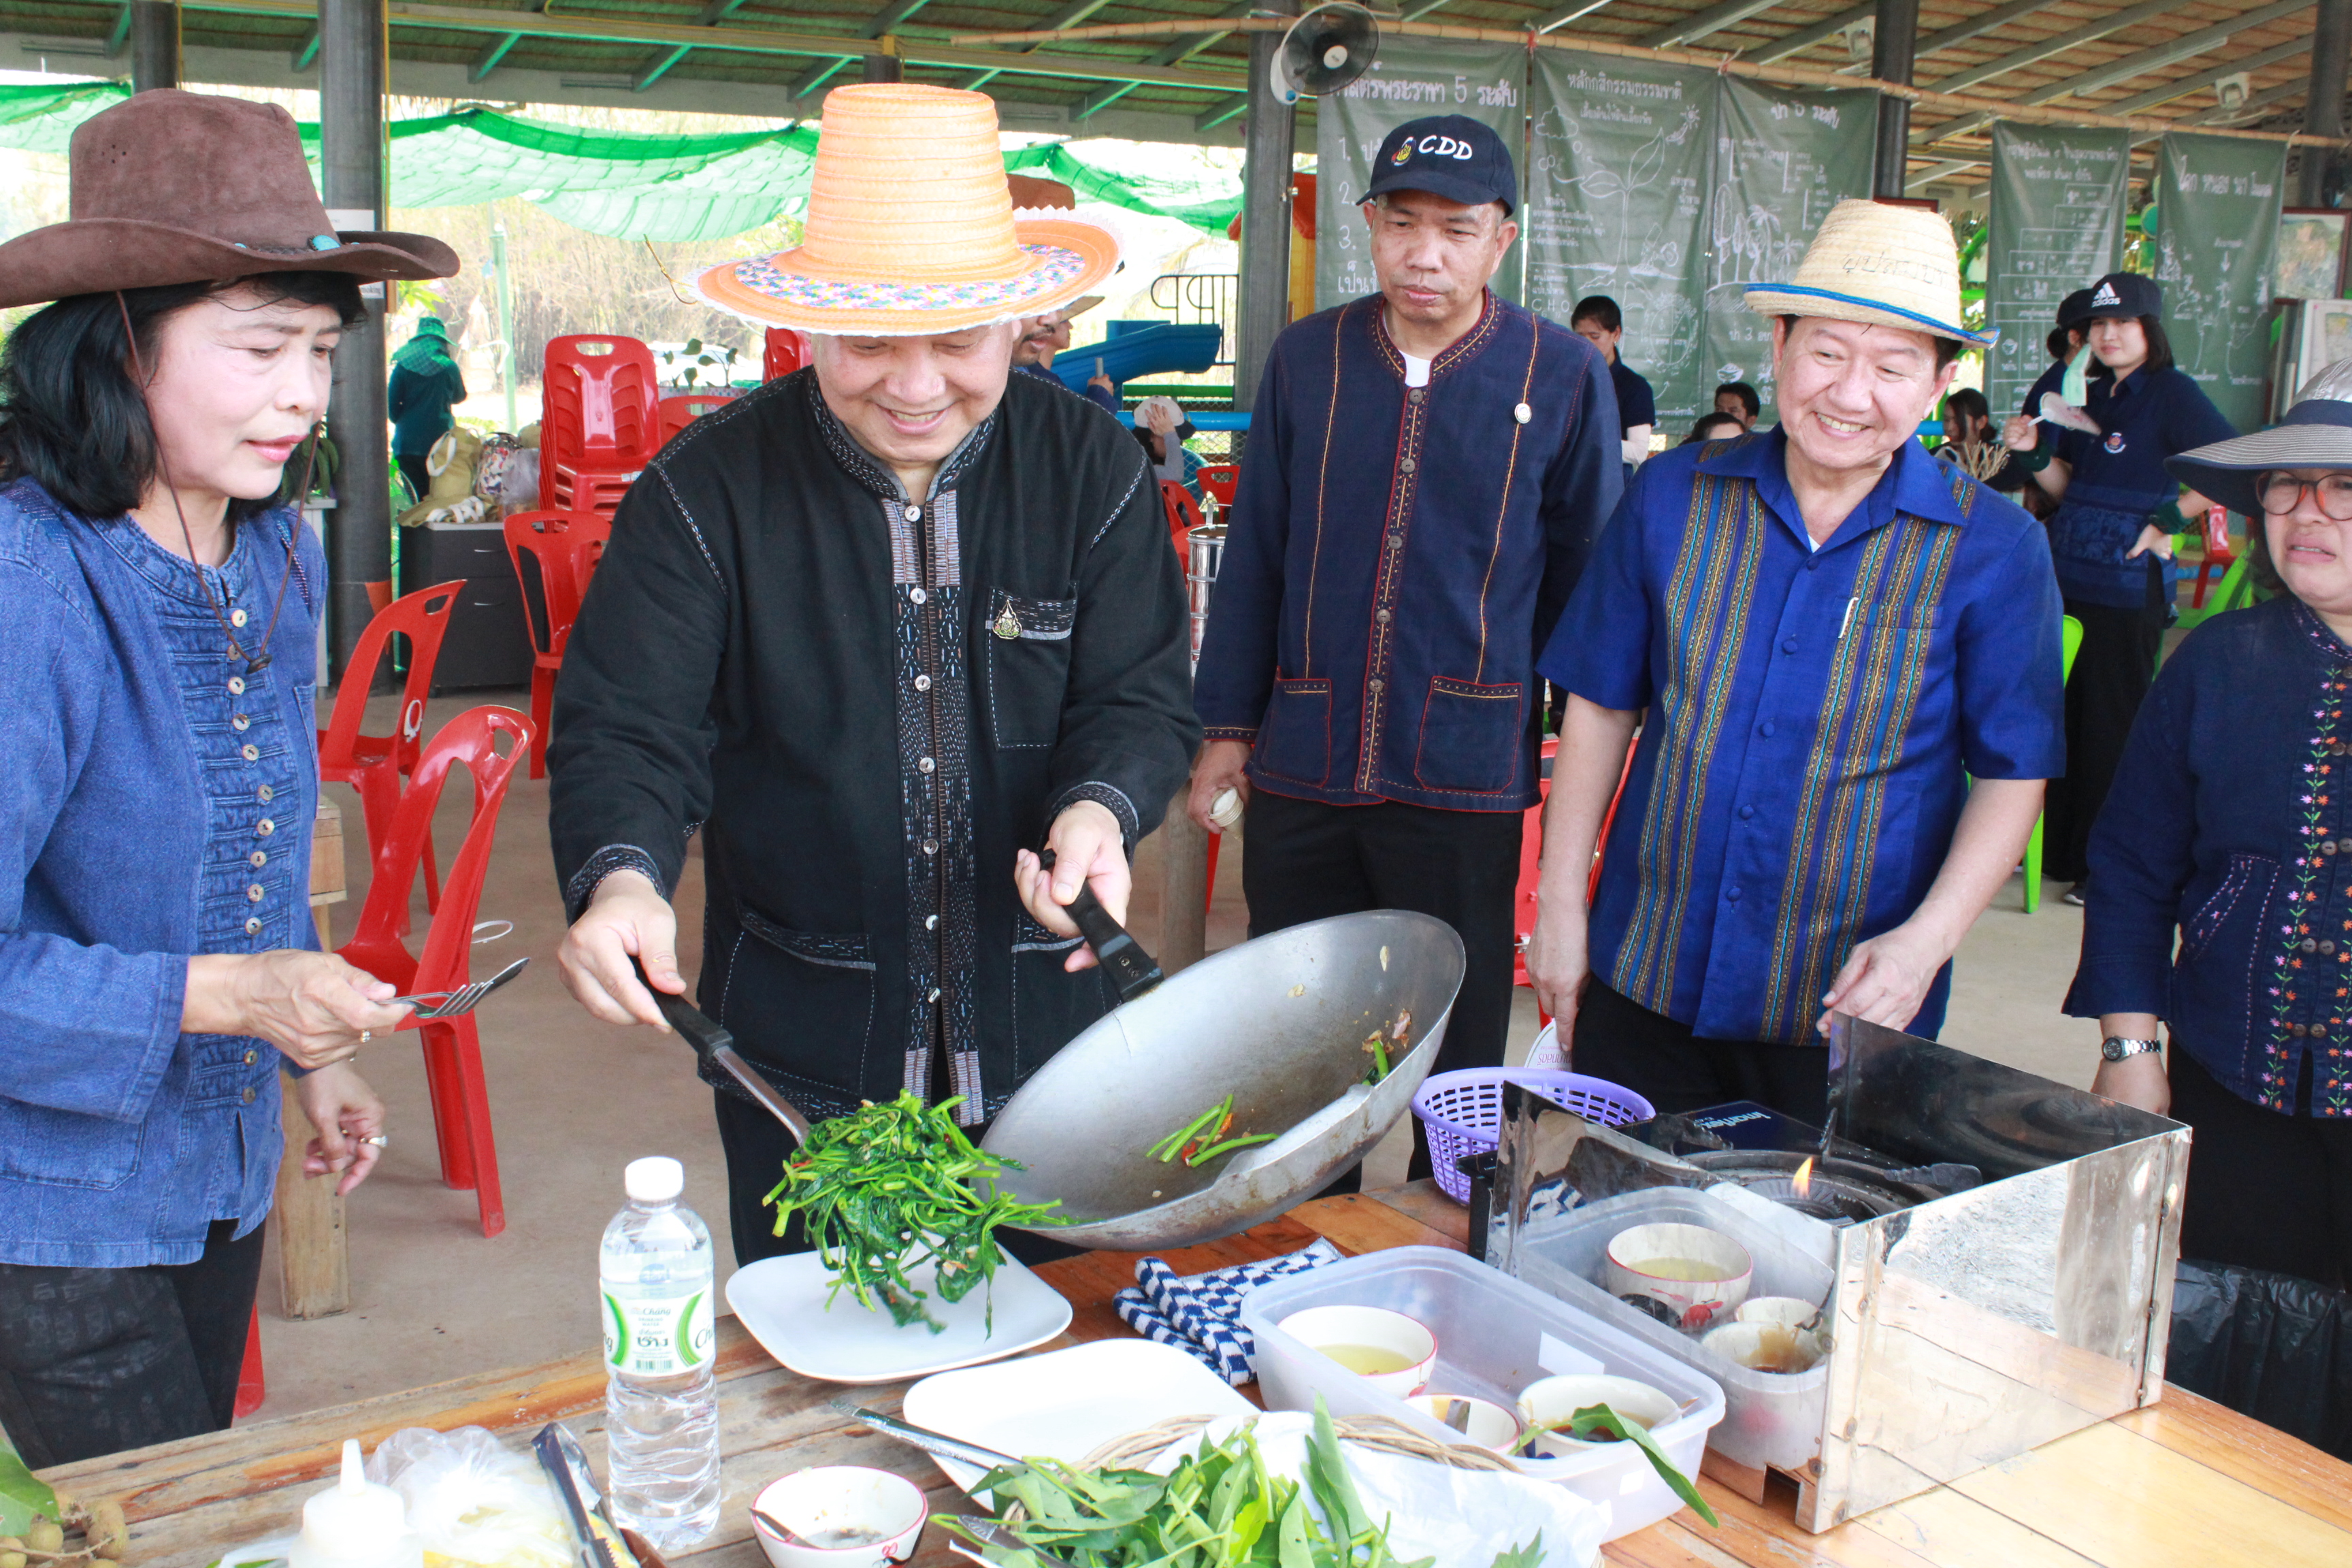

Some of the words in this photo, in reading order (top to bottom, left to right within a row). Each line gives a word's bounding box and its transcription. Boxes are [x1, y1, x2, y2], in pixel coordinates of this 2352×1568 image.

[1454, 76, 1467, 103] 5
[1476, 79, 1517, 108] ระดับ
[1418, 135, 1472, 160] CDD
[1339, 182, 1355, 205] 2.
[1339, 225, 1356, 250] 3.
[2091, 297, 2121, 308] adidas
[637, 1336, 668, 1347] ช้าง
